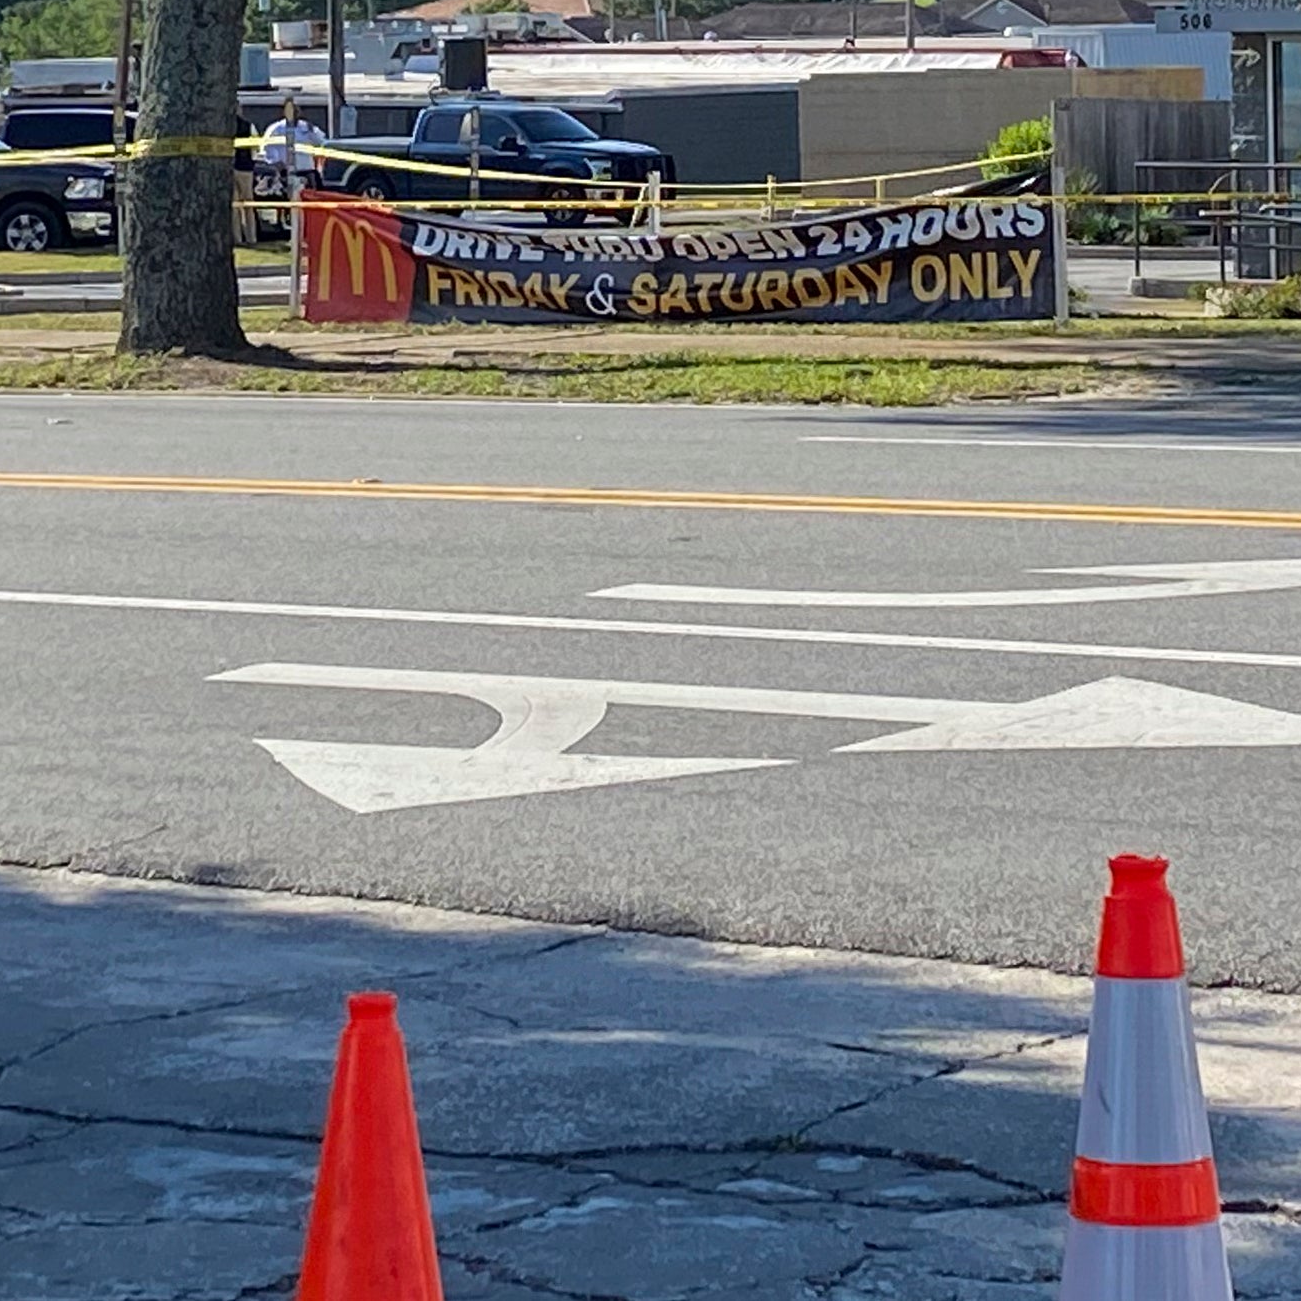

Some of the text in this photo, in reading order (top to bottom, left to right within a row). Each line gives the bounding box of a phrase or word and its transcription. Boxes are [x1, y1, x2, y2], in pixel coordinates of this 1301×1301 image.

[412, 202, 1046, 262] DRIVE THRU OPEN 24 HOURS
[425, 249, 1043, 315] FRIDAY & SATURDAY ONLY
